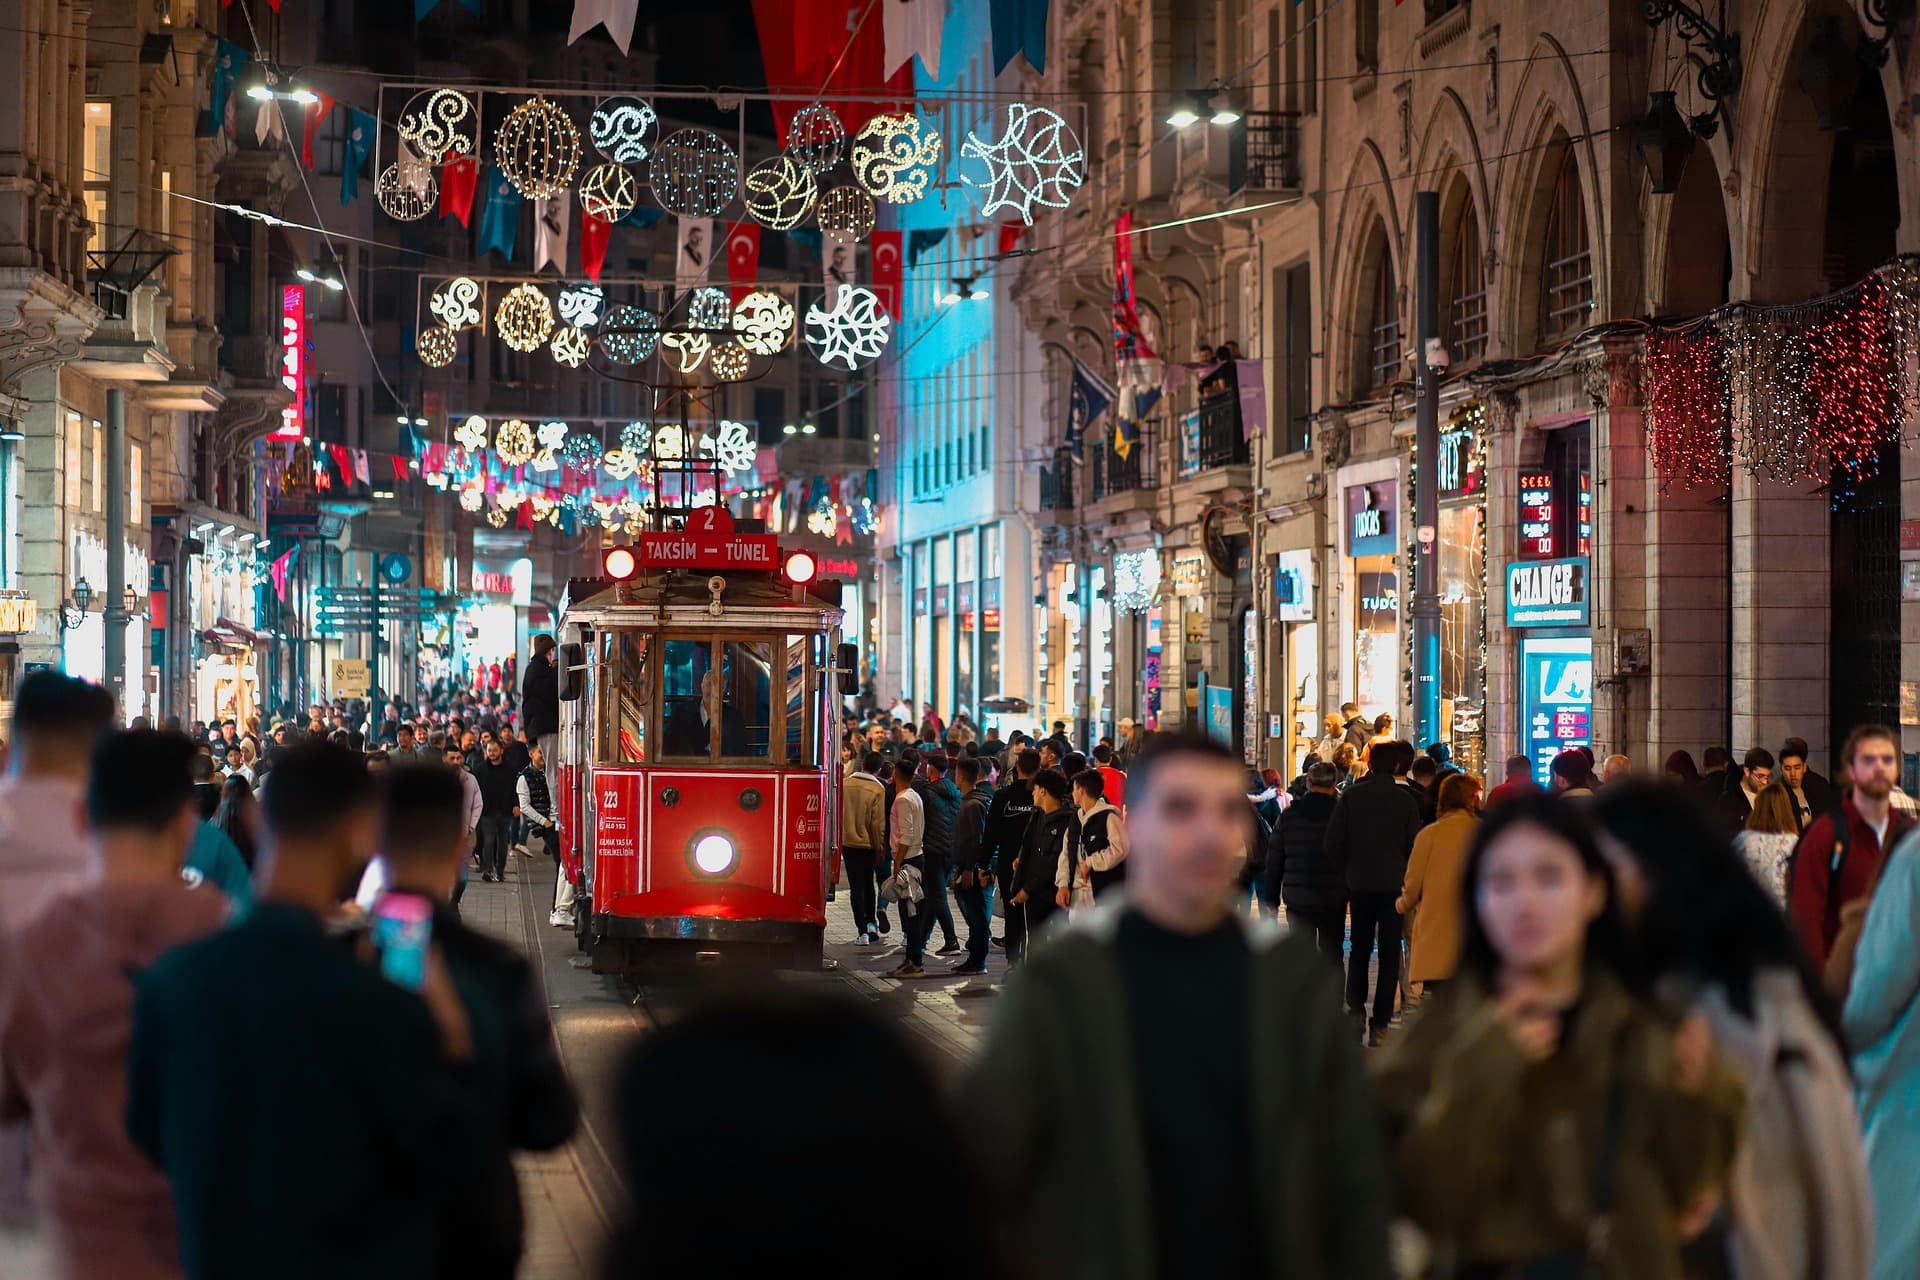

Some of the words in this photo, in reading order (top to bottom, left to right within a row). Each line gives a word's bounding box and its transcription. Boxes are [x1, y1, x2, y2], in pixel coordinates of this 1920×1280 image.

[704, 508, 715, 530] 2
[646, 537, 697, 560] TAKSİM
[726, 538, 770, 562] TÜNEL
[1510, 563, 1573, 607] CHANGE
[604, 791, 618, 809] 223
[806, 794, 819, 812] 223
